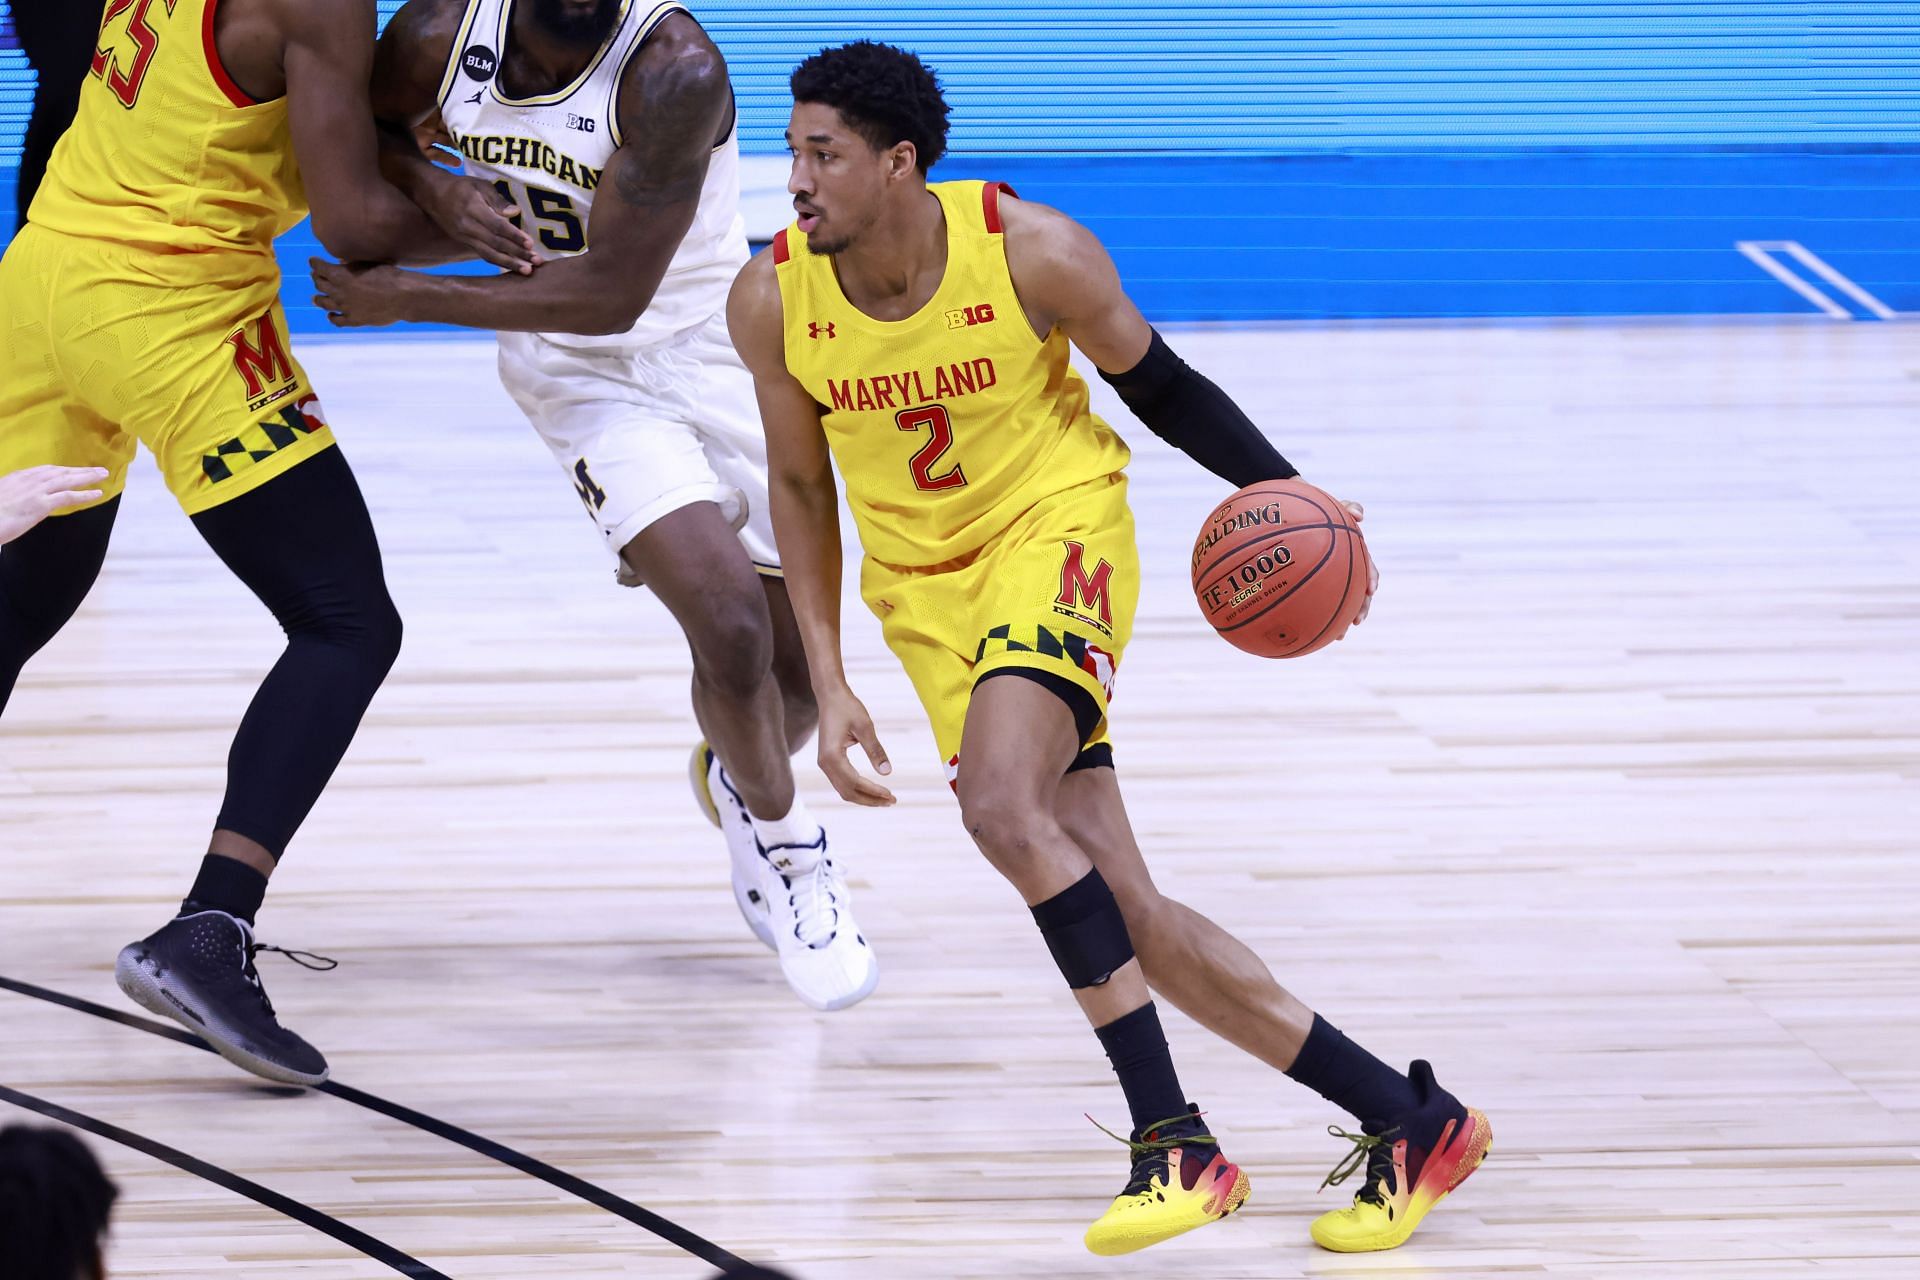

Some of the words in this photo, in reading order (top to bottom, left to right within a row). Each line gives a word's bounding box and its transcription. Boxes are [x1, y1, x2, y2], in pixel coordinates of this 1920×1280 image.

[465, 54, 493, 73] BLM
[452, 129, 603, 190] MICHIGAN
[225, 309, 296, 401] M
[827, 357, 997, 412] MARYLAND
[895, 404, 968, 491] 2
[1191, 502, 1282, 577] SPALDING
[1054, 540, 1115, 631] M
[1202, 545, 1291, 610] TF-1000
[1230, 580, 1263, 607] LEGACY
[1263, 580, 1288, 598] DESIGN
